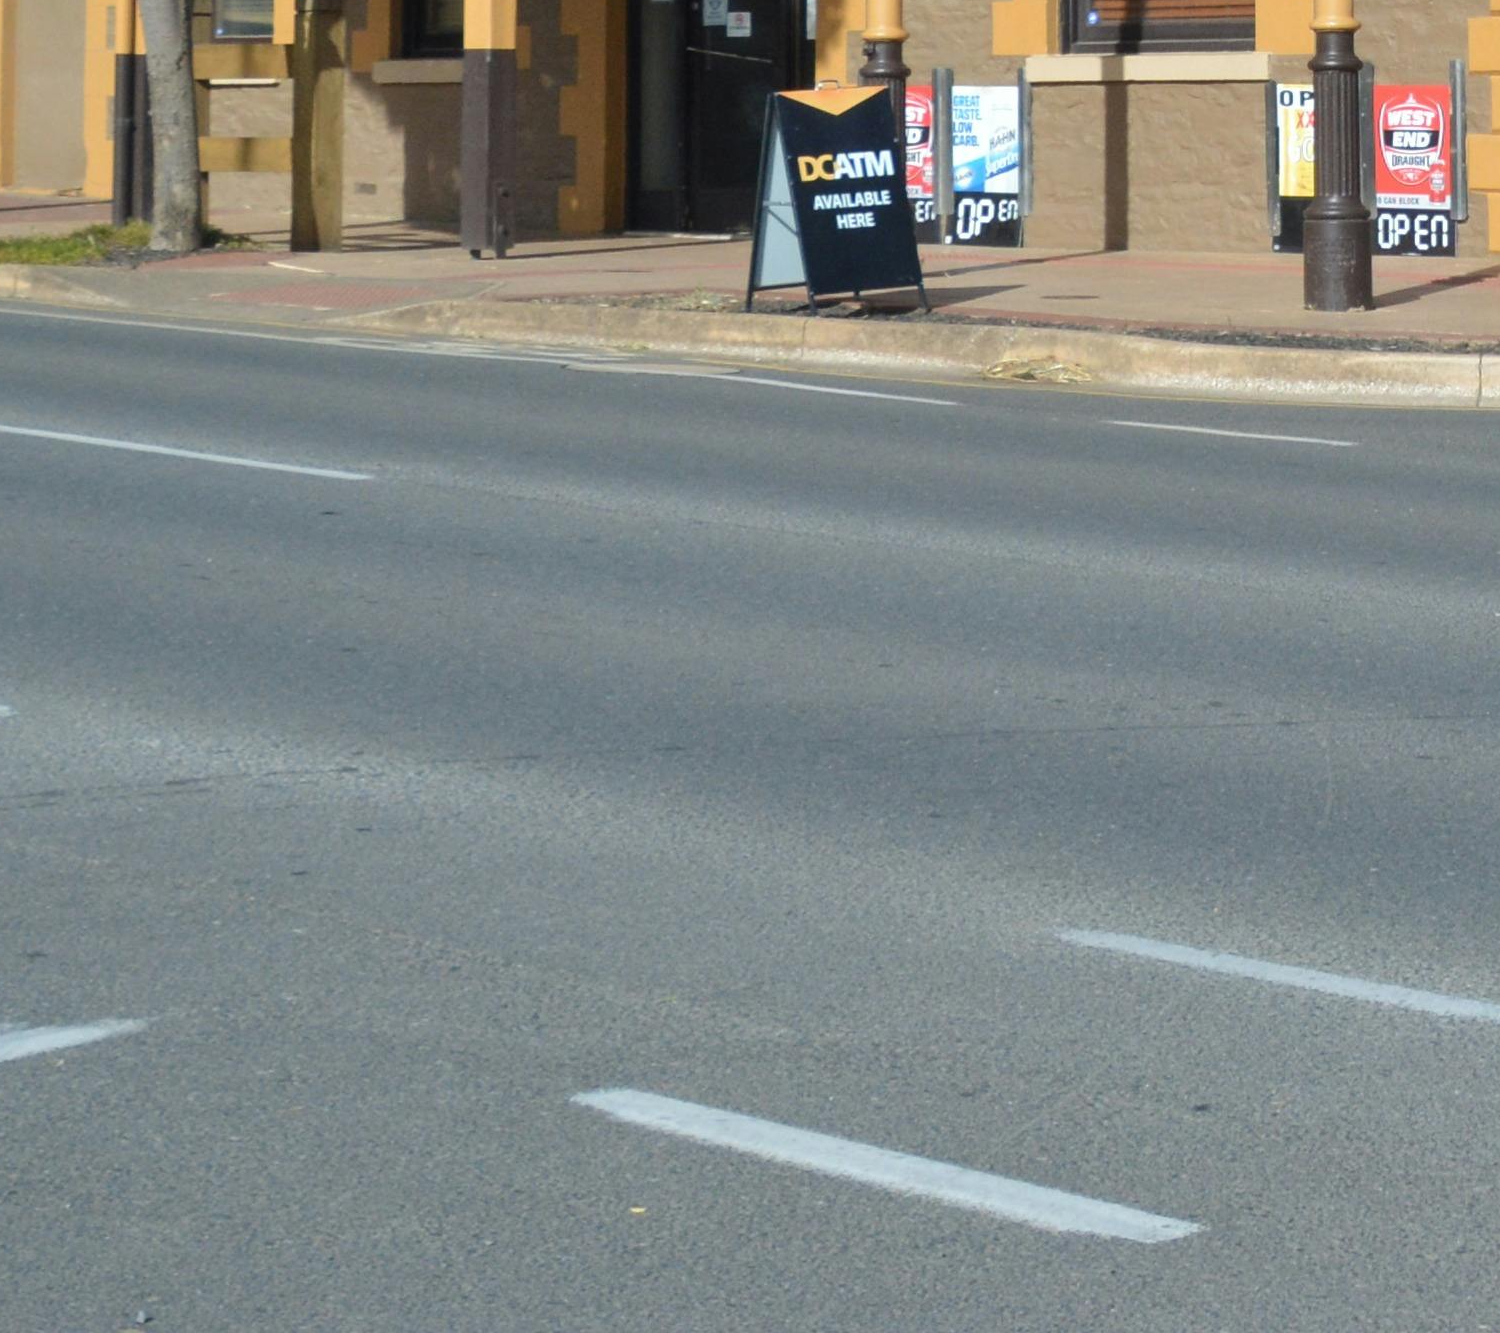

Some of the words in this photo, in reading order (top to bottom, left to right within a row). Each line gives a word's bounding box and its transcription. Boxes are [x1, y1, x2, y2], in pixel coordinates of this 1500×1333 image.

[953, 95, 980, 107] GREAT
[1280, 89, 1314, 106] OP
[1386, 110, 1435, 127] WEST
[952, 121, 973, 134] LOW
[989, 128, 1017, 149] HAHN
[1391, 131, 1431, 148] END
[1391, 153, 1431, 167] DRAUGHT
[813, 190, 893, 211] AVAILABLE
[1383, 196, 1396, 205] CAN
[1398, 196, 1420, 205] BLOCK
[836, 212, 876, 229] HERE
[1378, 212, 1449, 251] OPEN
